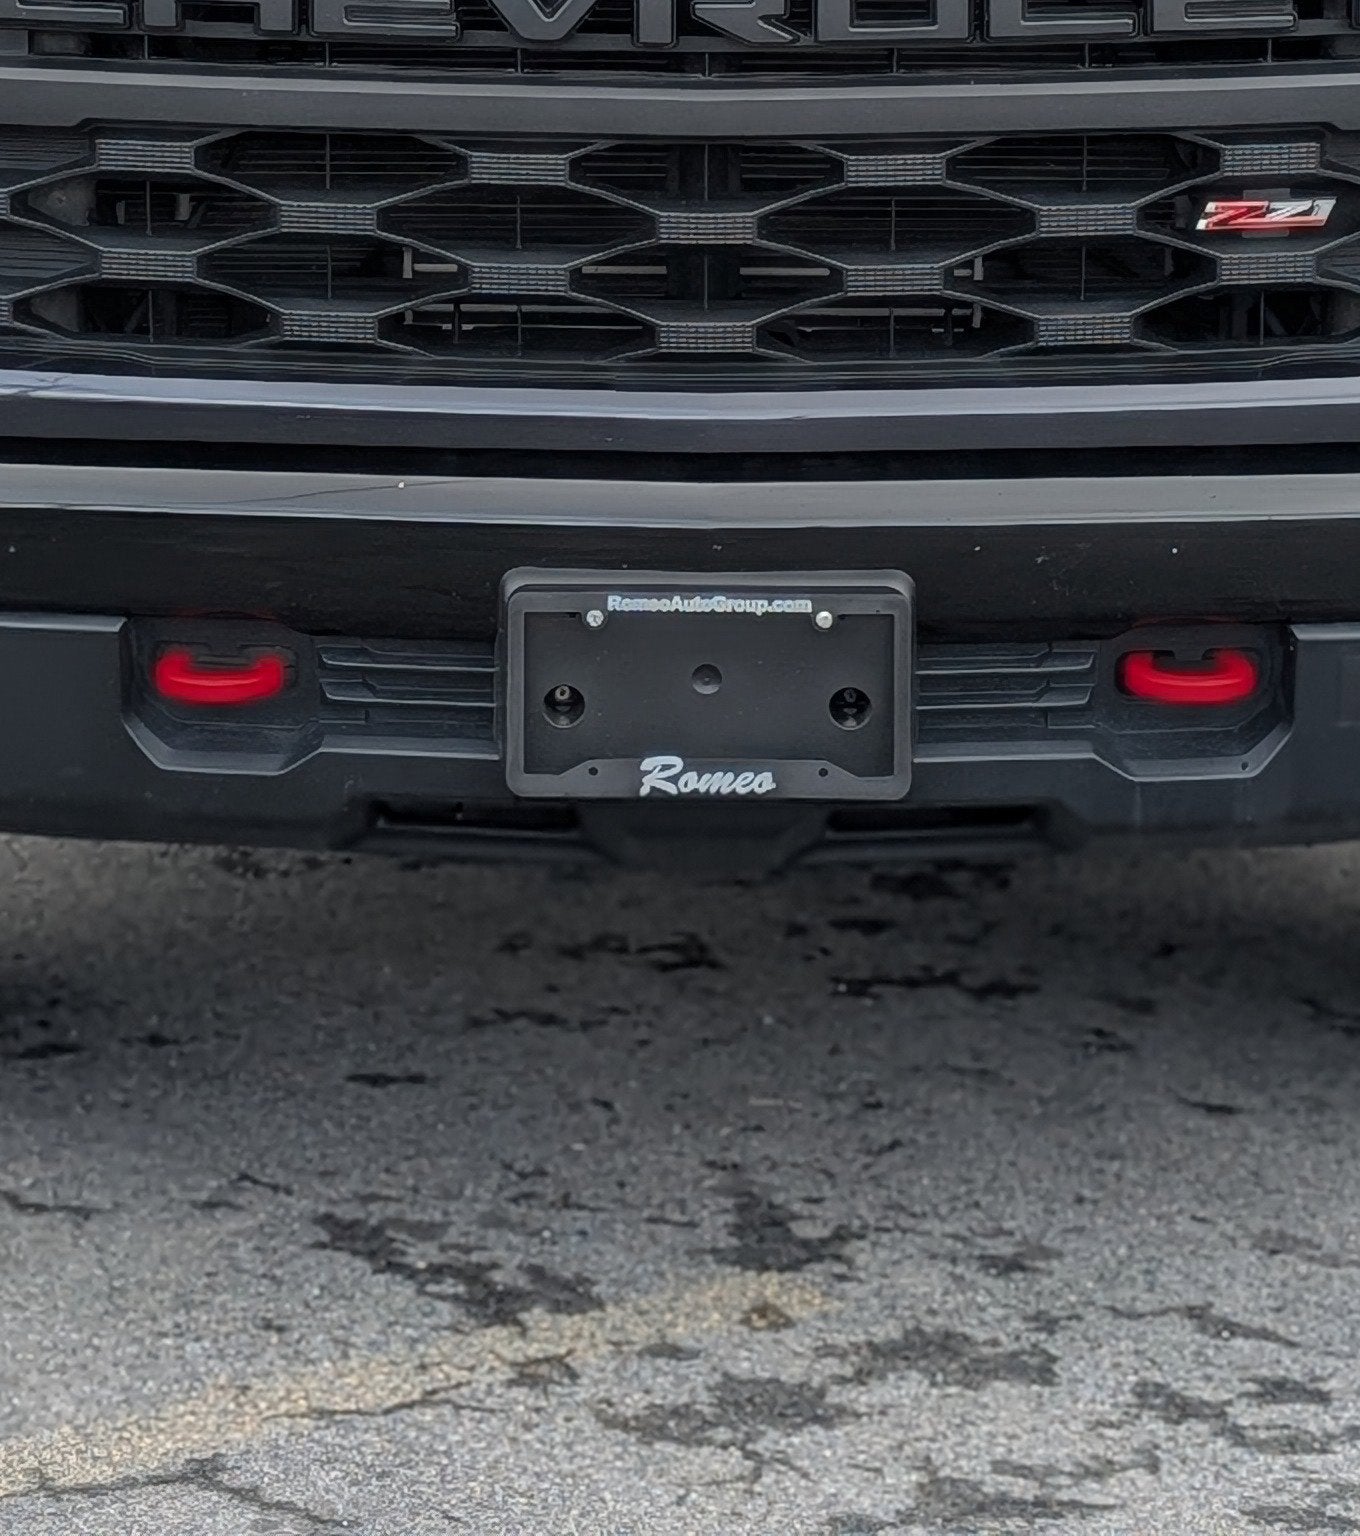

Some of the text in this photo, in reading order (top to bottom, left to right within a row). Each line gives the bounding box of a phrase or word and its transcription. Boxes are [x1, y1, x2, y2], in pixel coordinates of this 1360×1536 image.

[1195, 198, 1336, 230] Z71
[607, 594, 813, 616] RomeoAutoGroup.com
[639, 755, 777, 795] Romeo
